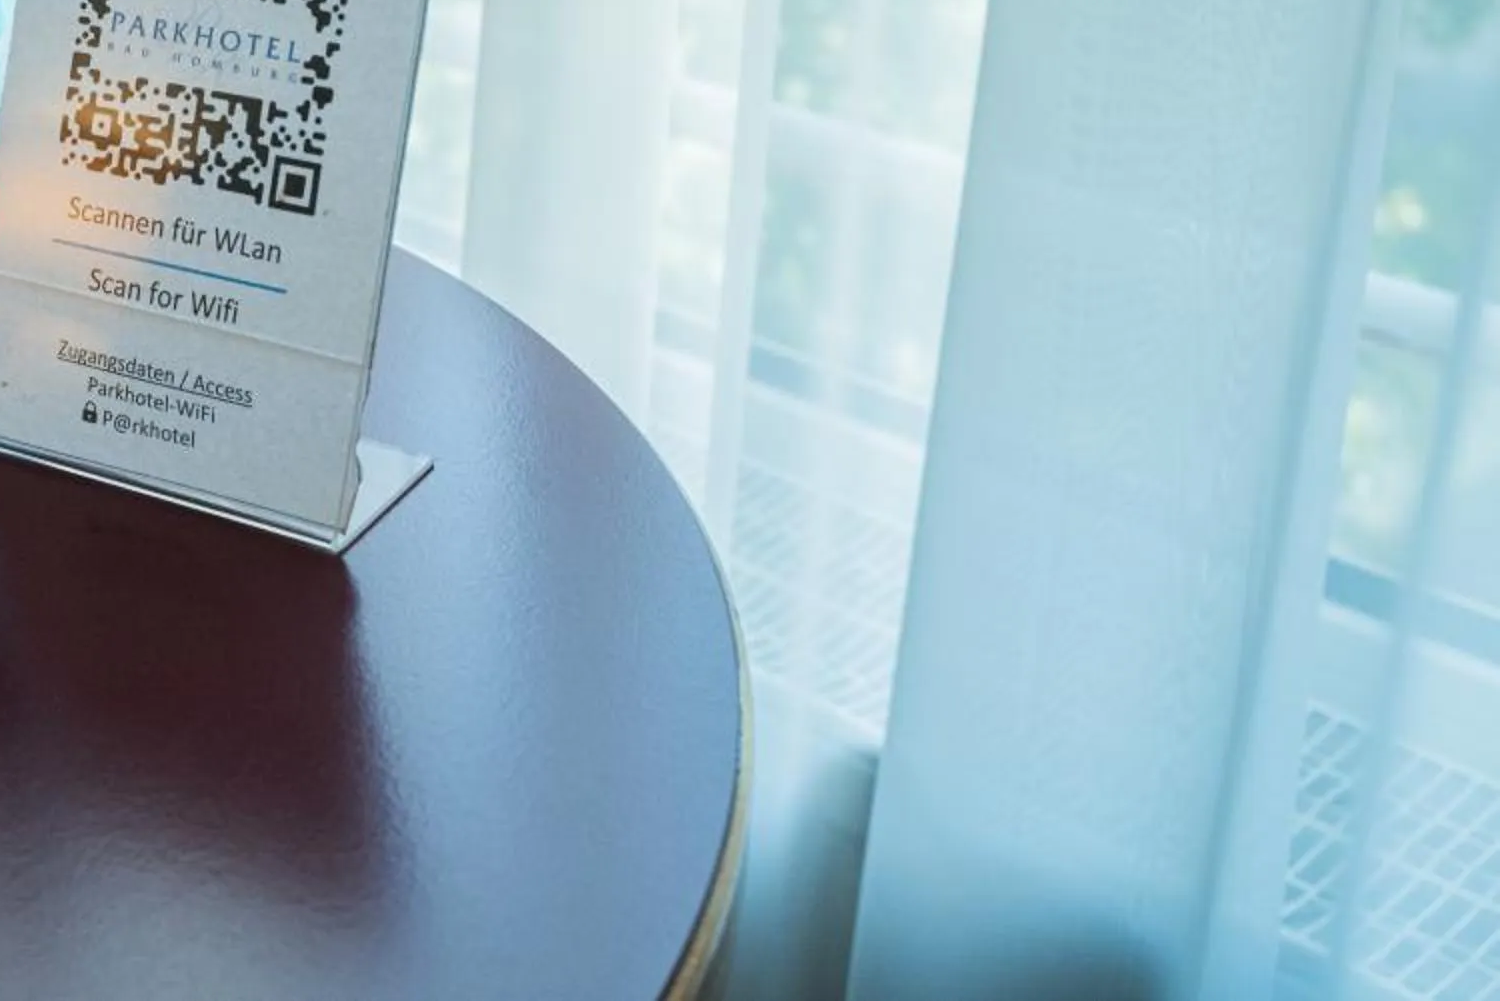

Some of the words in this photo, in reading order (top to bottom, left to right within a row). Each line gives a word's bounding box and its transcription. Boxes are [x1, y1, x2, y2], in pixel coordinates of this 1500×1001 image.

[107, 42, 149, 58] BAD
[172, 52, 298, 84] HOMBURG
[111, 10, 301, 63] PARKHOTEL
[67, 196, 164, 239] Scannen
[172, 216, 207, 247] für
[215, 226, 282, 264] WLan
[88, 268, 141, 302] Scan
[149, 280, 184, 310] for
[192, 291, 239, 325] Wifi
[58, 339, 175, 385] Zugangsdaten
[193, 374, 253, 405] Access
[87, 376, 216, 424] Parkhotel-WiFi
[103, 409, 196, 448] P@rkhotel
